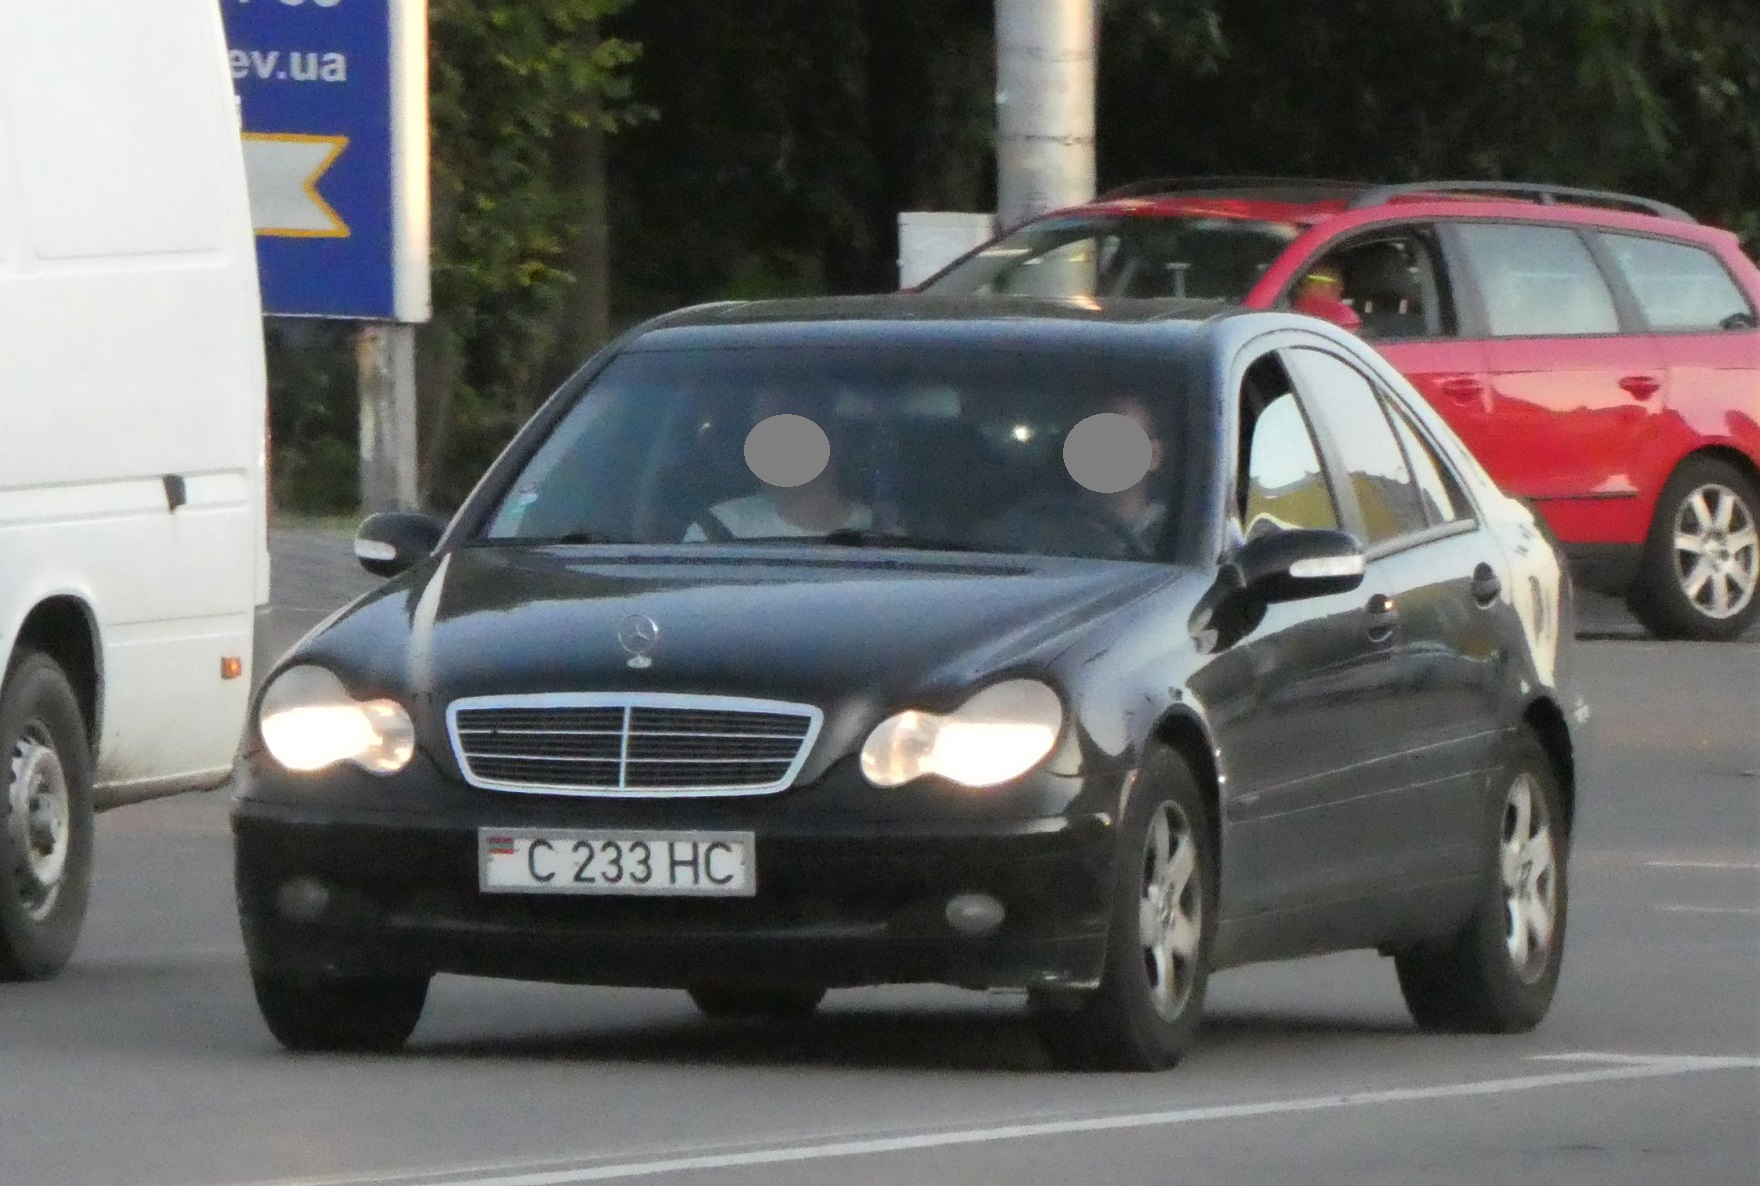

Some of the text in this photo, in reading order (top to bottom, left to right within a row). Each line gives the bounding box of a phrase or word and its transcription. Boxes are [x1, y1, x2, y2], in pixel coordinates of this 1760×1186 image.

[528, 838, 734, 885] C 233 HC
